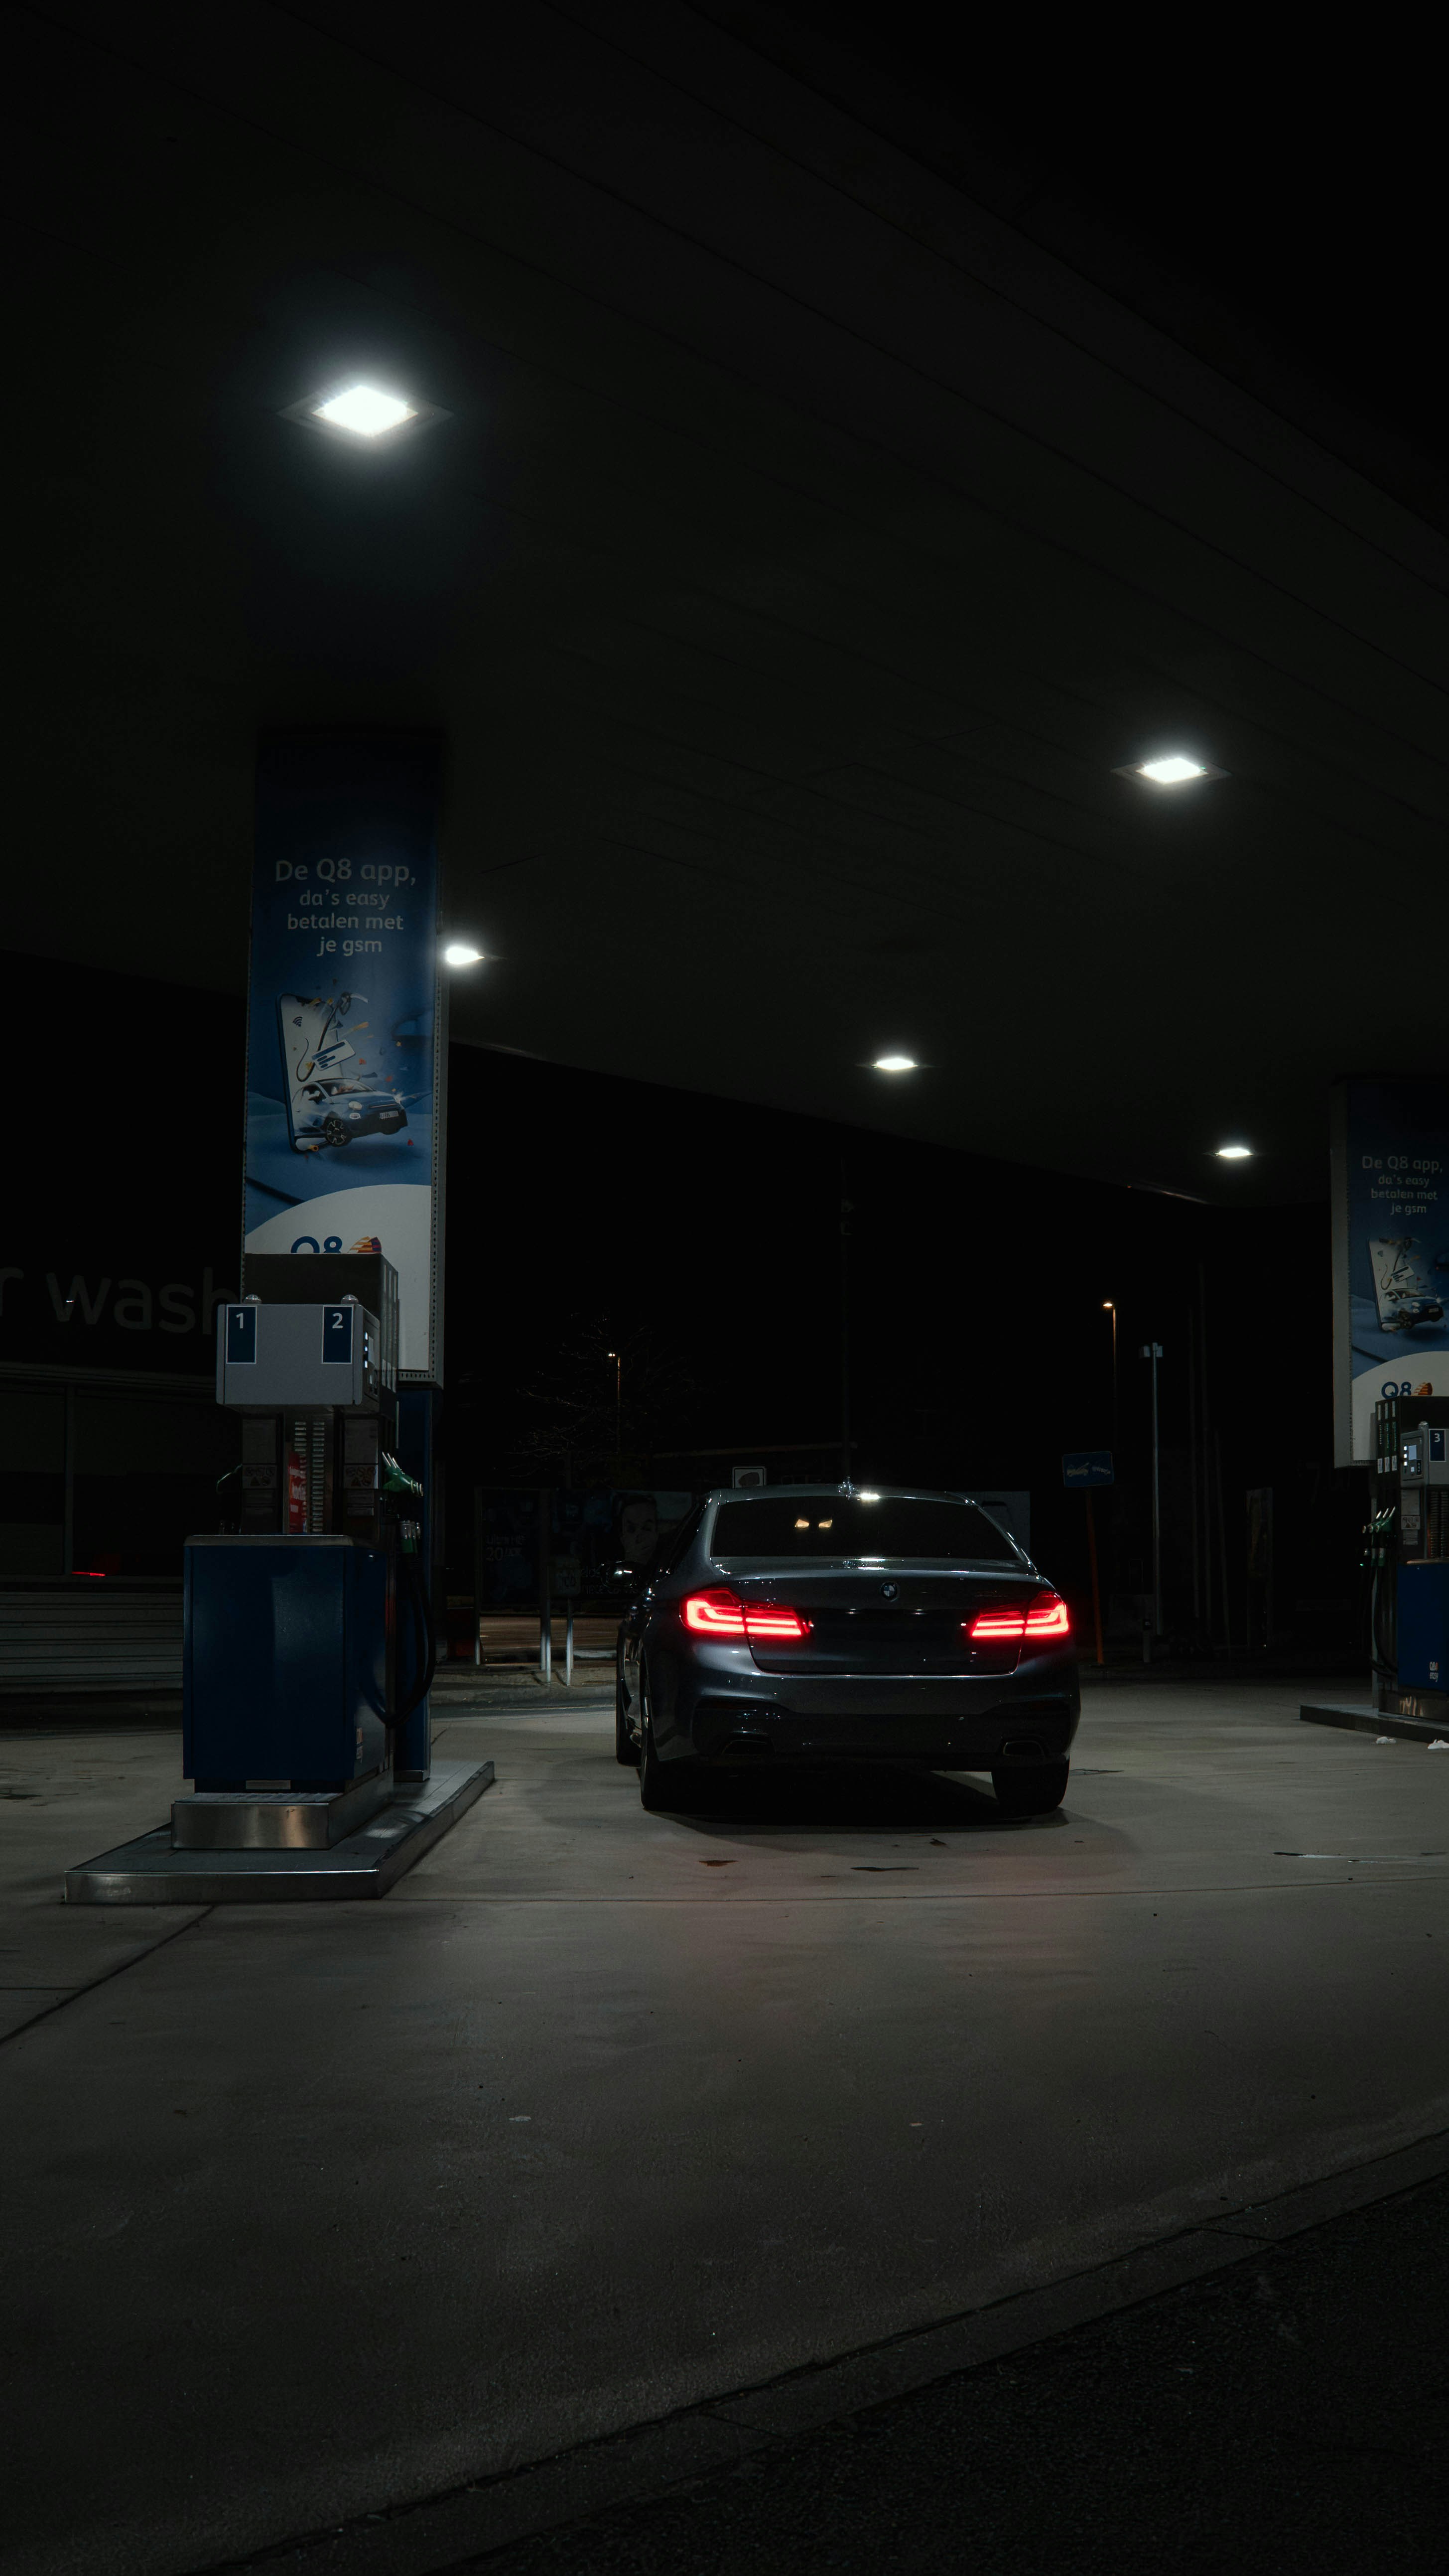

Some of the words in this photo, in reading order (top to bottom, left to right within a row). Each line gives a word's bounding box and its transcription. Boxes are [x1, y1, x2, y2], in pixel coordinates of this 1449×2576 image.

[275, 860, 309, 882] De
[316, 858, 352, 883] Q8
[360, 864, 416, 887] app,
[346, 893, 390, 911] easy
[288, 913, 360, 930] betalen
[365, 916, 404, 930] met
[316, 937, 337, 957] je
[343, 940, 383, 957] gsm
[1361, 1156, 1382, 1169] De
[1387, 1155, 1408, 1171] Q8
[1412, 1159, 1443, 1174] app,
[1405, 1177, 1430, 1188] easy
[1370, 1188, 1414, 1199] betalen
[1416, 1190, 1439, 1200] met
[1390, 1202, 1402, 1216] je
[1404, 1205, 1427, 1216] gsm
[46, 1267, 241, 1336] wash
[236, 1313, 244, 1329] 1
[332, 1313, 343, 1329] 2
[1434, 1433, 1441, 1443] 3
